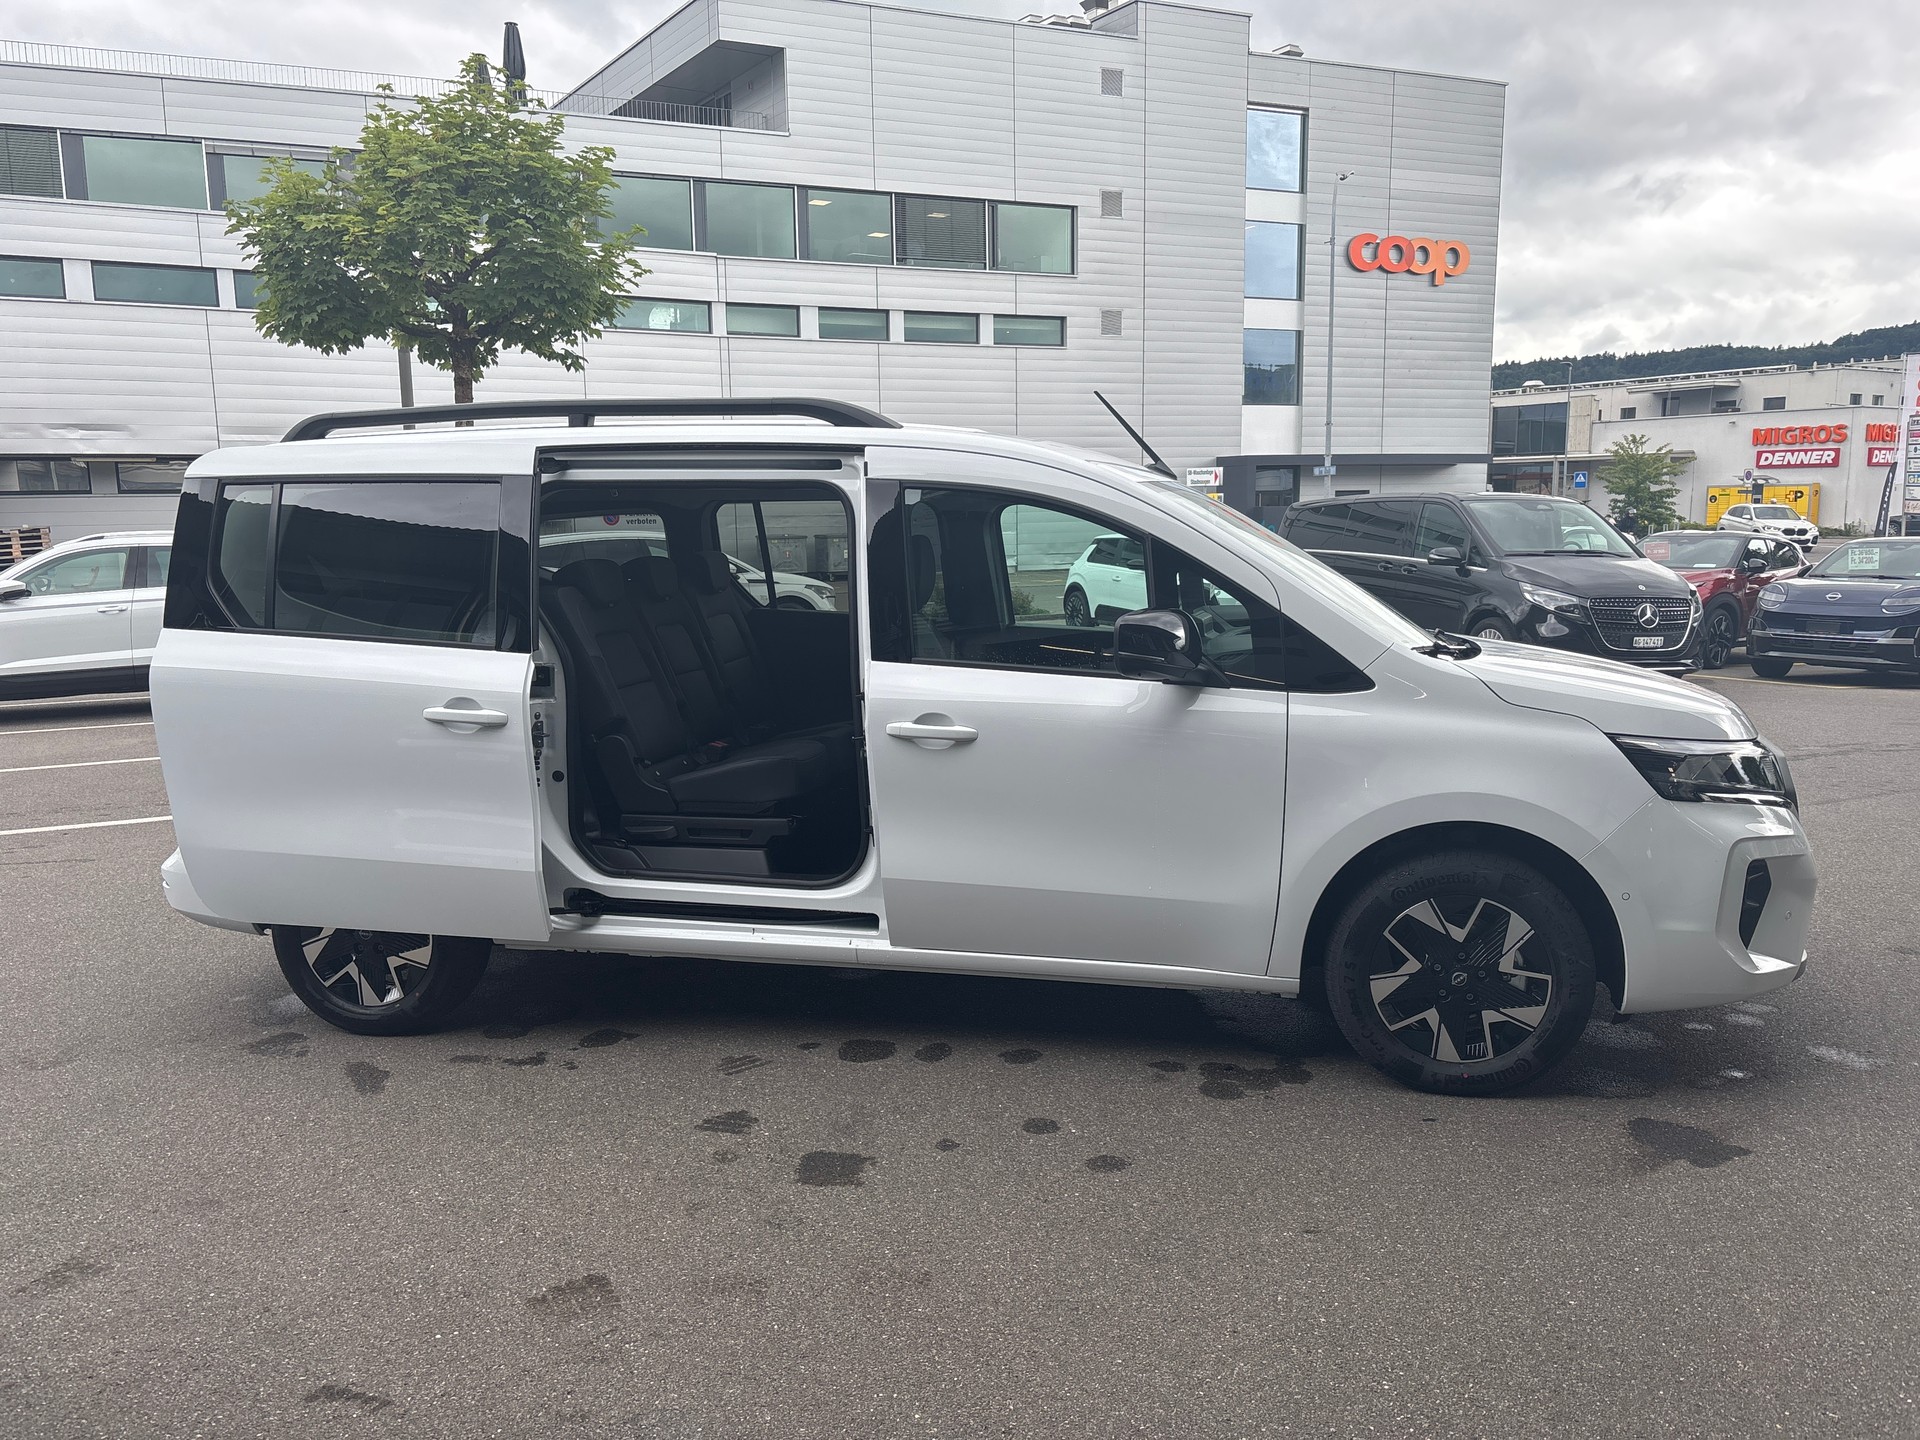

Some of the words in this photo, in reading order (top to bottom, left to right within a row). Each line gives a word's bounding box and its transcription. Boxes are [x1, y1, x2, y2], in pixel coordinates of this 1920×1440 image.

[1347, 232, 1471, 286] coop
[1753, 424, 1847, 446] MIGROS
[1759, 451, 1835, 465] DENNER
[1872, 450, 1897, 463] DEN
